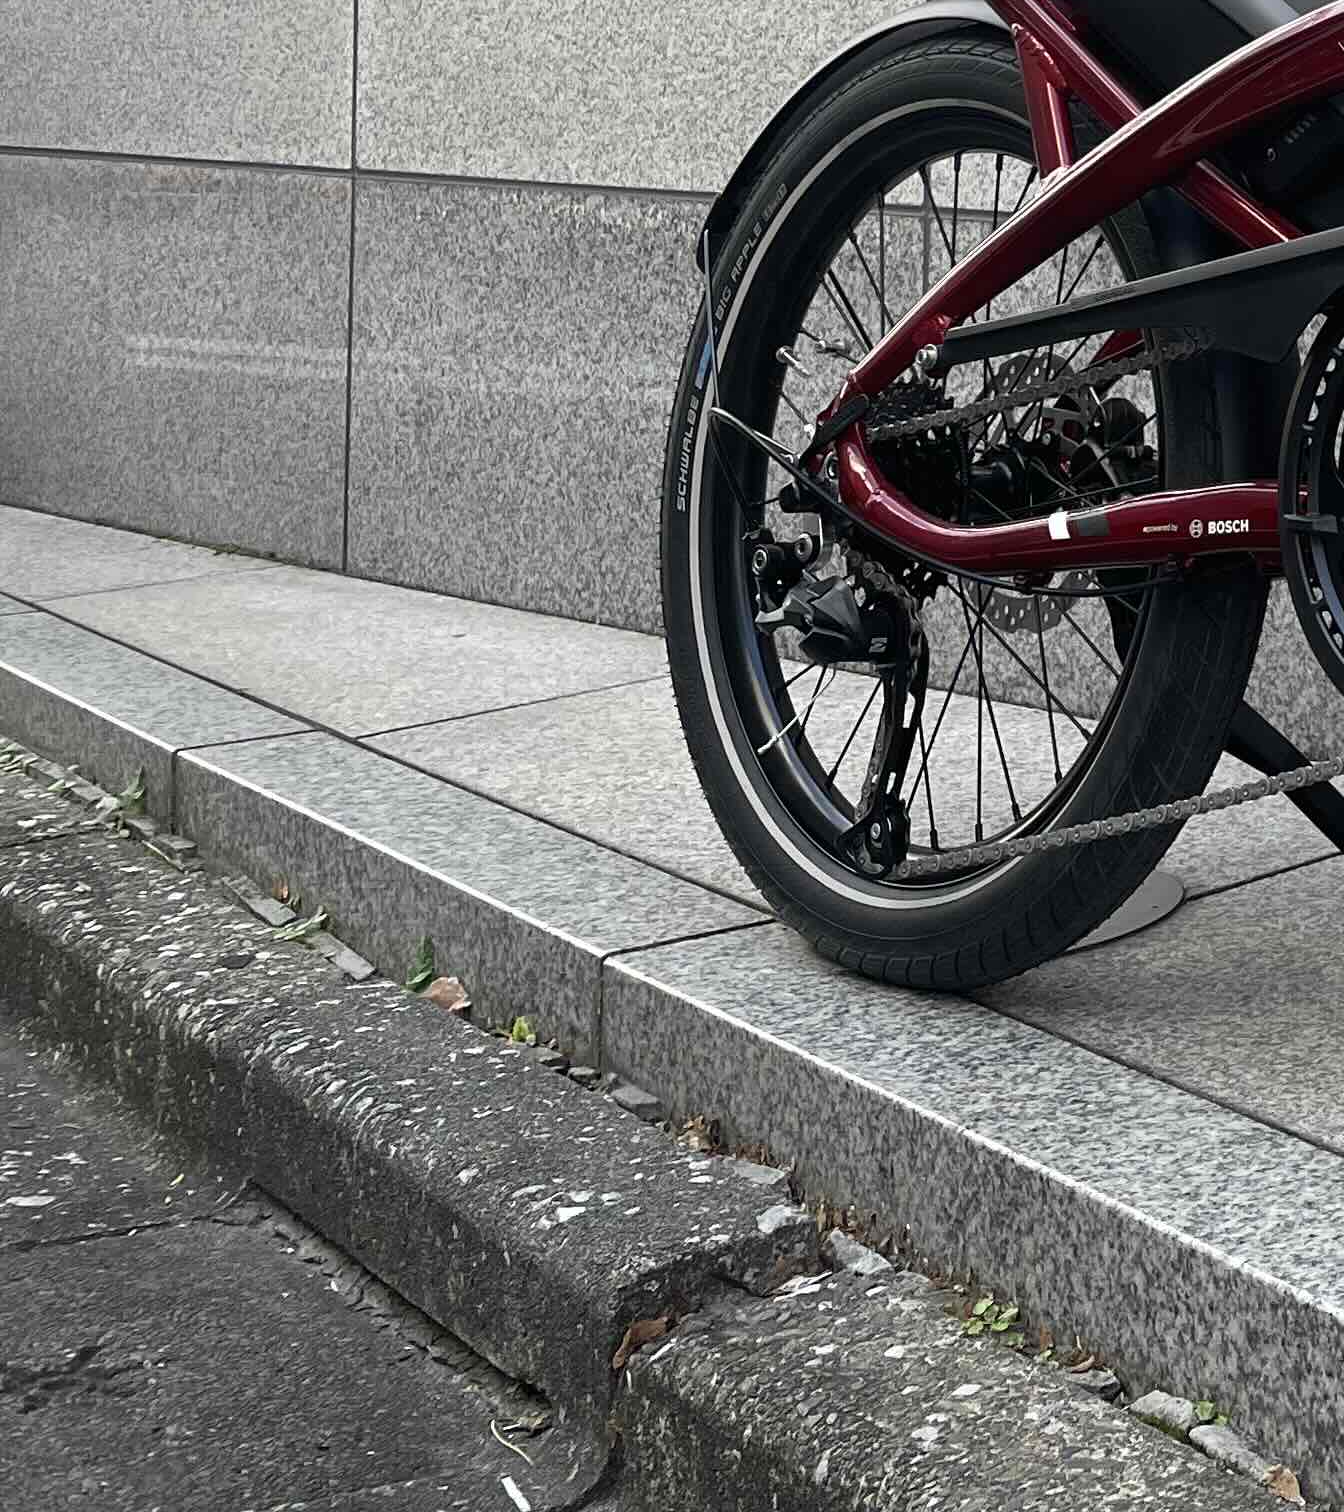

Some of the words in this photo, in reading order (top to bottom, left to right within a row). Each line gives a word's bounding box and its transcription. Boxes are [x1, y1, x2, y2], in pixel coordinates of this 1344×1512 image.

[714, 287, 732, 321] BIG
[730, 221, 763, 282] APPLE
[676, 394, 700, 513] SCHWALBE
[1207, 518, 1249, 535] BOSCH
